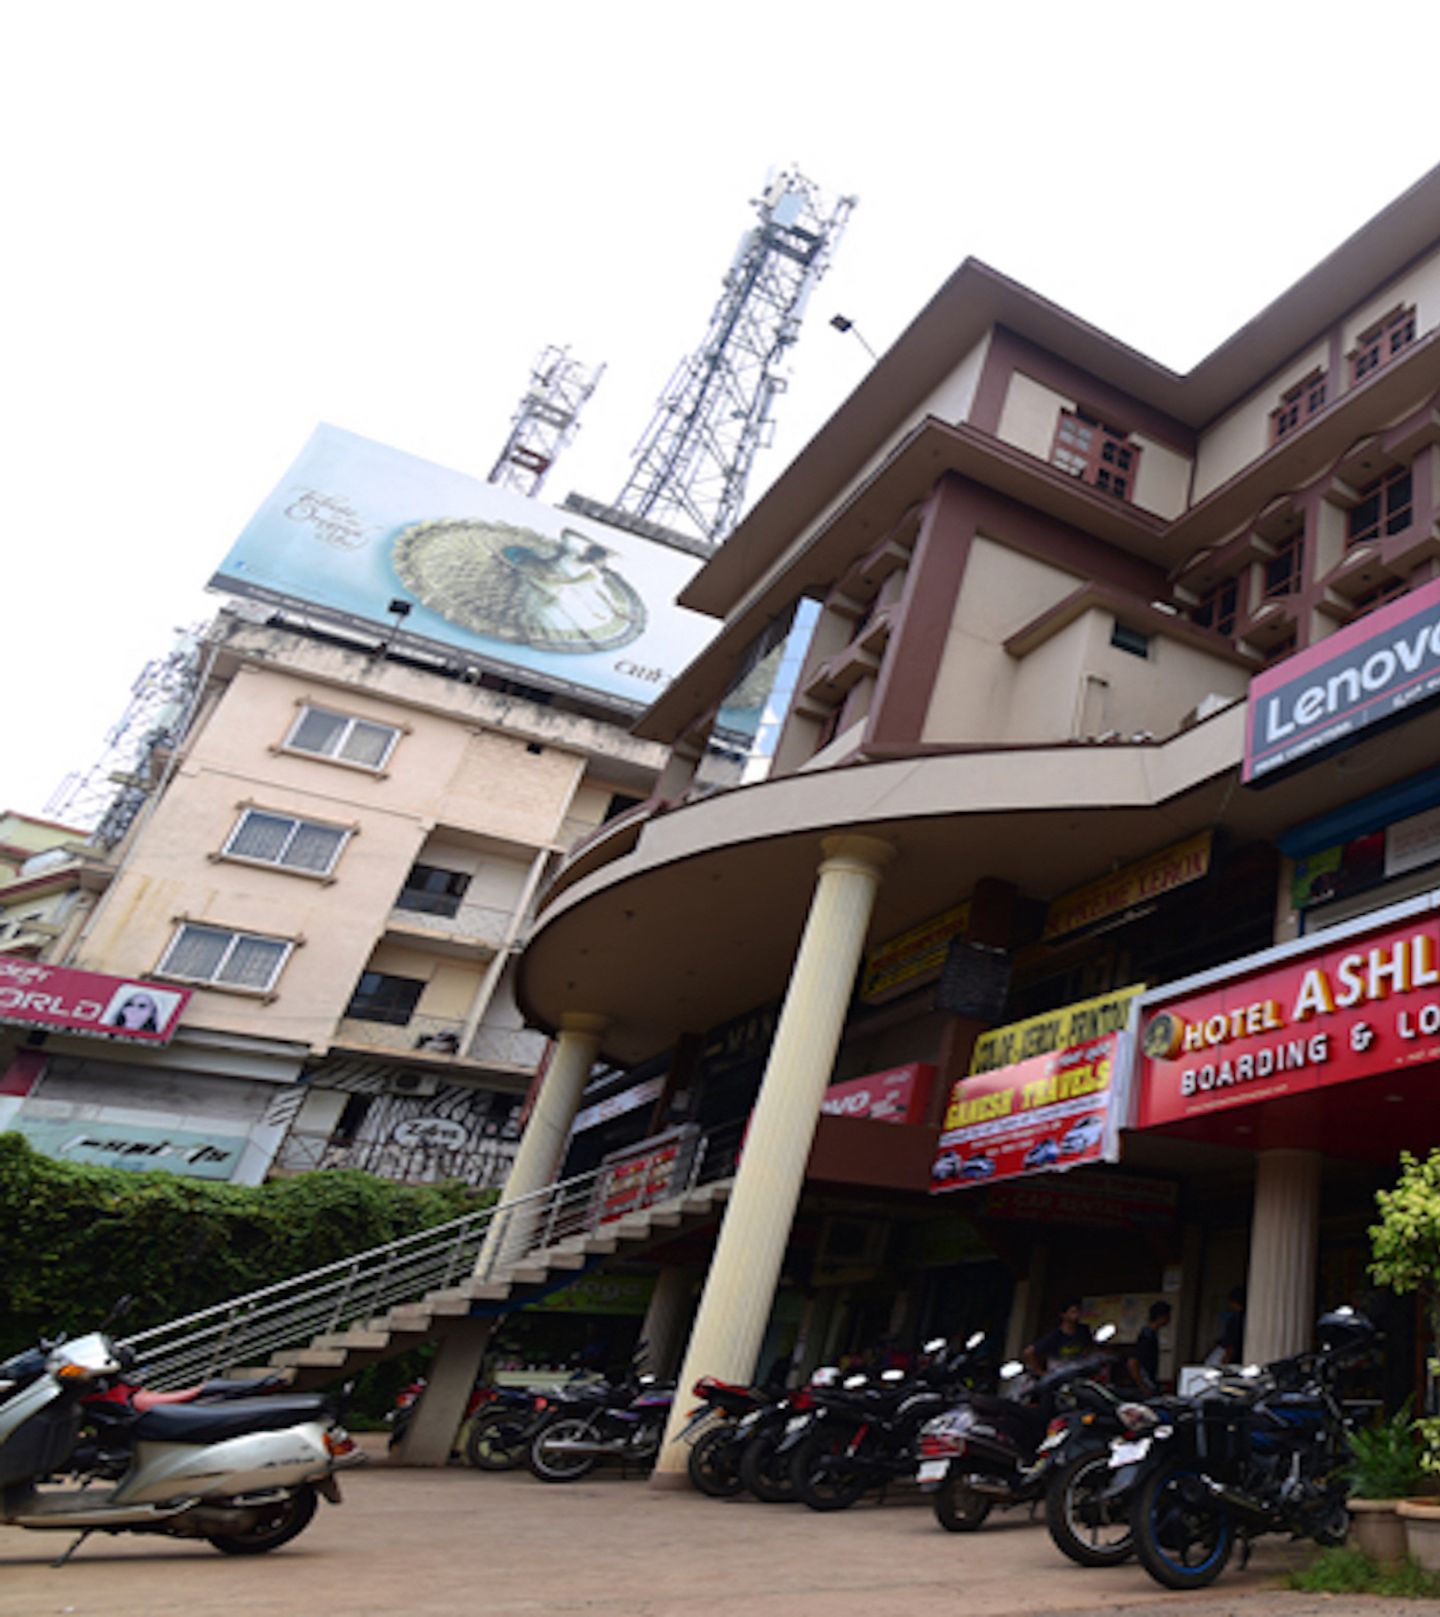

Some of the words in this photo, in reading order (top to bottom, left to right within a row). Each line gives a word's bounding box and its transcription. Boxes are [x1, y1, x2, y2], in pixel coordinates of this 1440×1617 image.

[1180, 1032, 1329, 1097] BOARDING
[1351, 1021, 1374, 1054] &
[1182, 1000, 1283, 1053] HOTEL
[945, 1088, 1015, 1131] GANESH
[1021, 1058, 1111, 1110] TRAVELS
